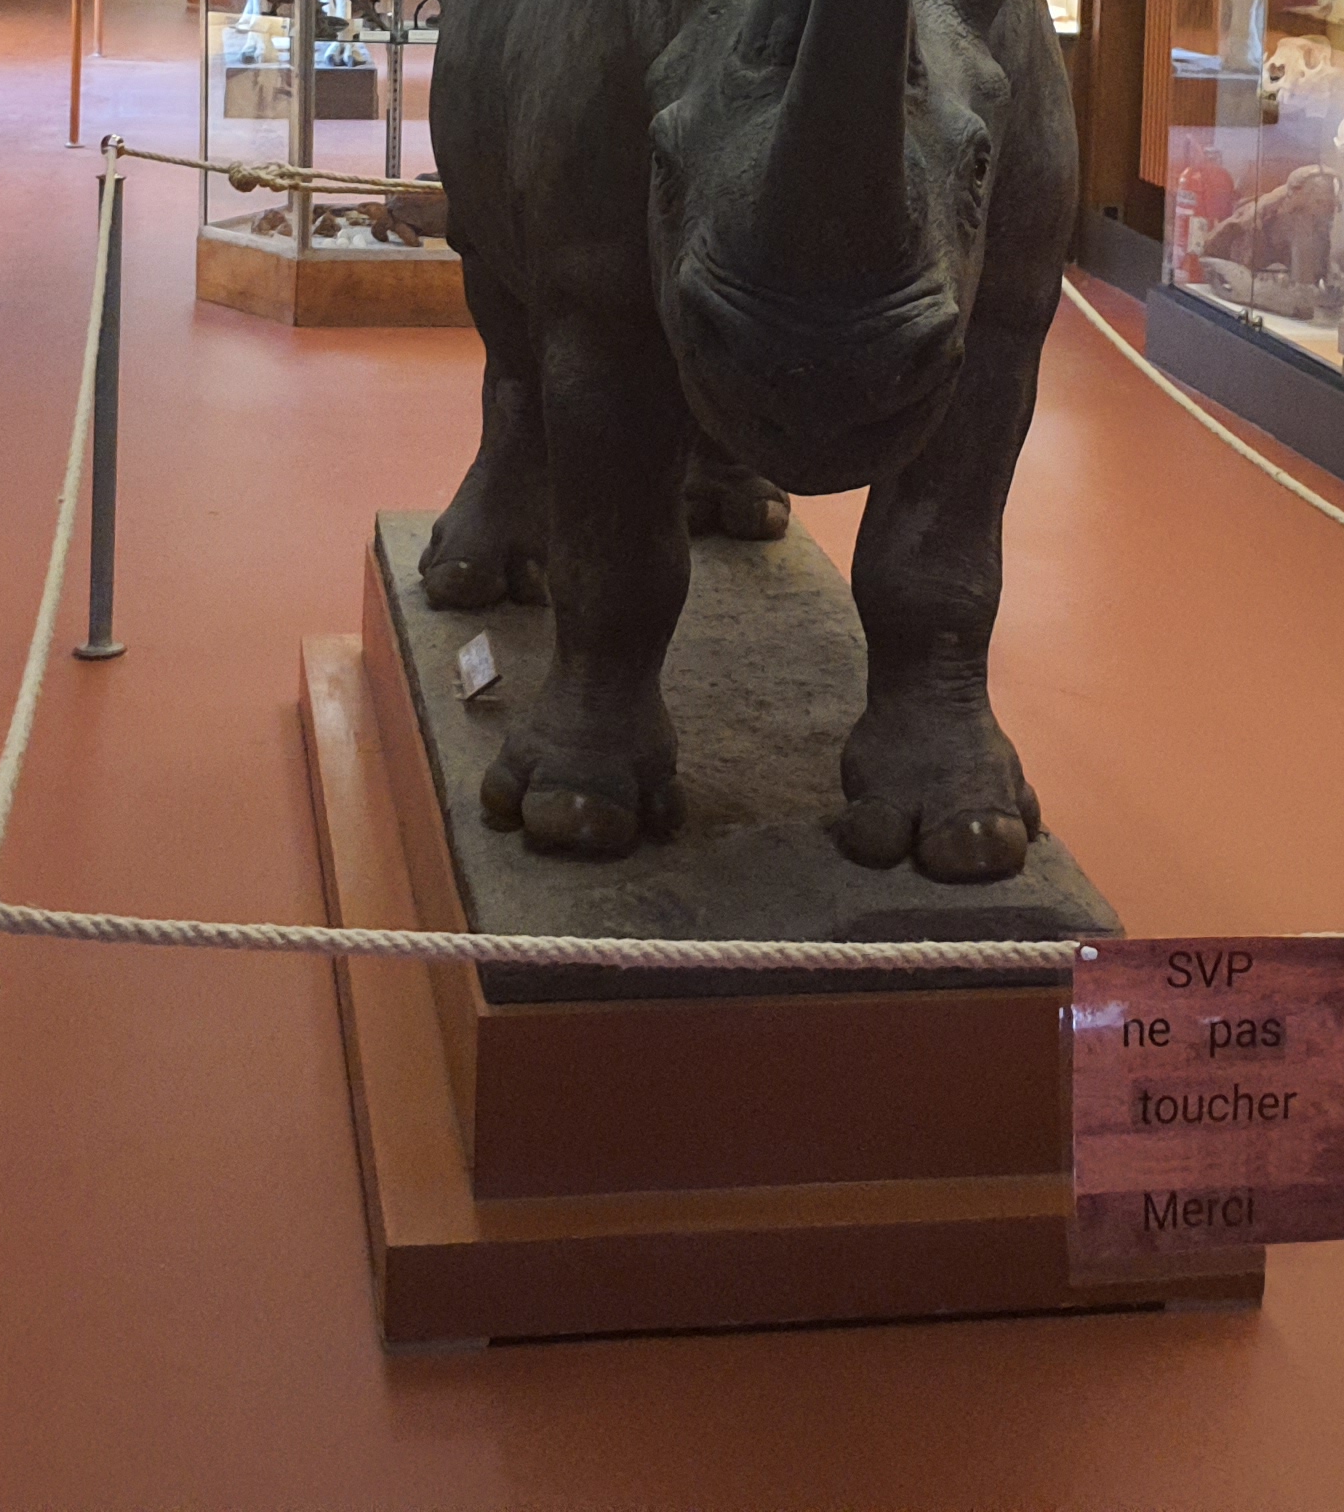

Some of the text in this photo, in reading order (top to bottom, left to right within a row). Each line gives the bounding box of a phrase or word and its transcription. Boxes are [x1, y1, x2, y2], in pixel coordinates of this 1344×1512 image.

[1167, 951, 1254, 989] SVP
[1123, 1016, 1283, 1059] ne pas
[1138, 1083, 1298, 1125] toucher
[1142, 1188, 1255, 1233] Merci
